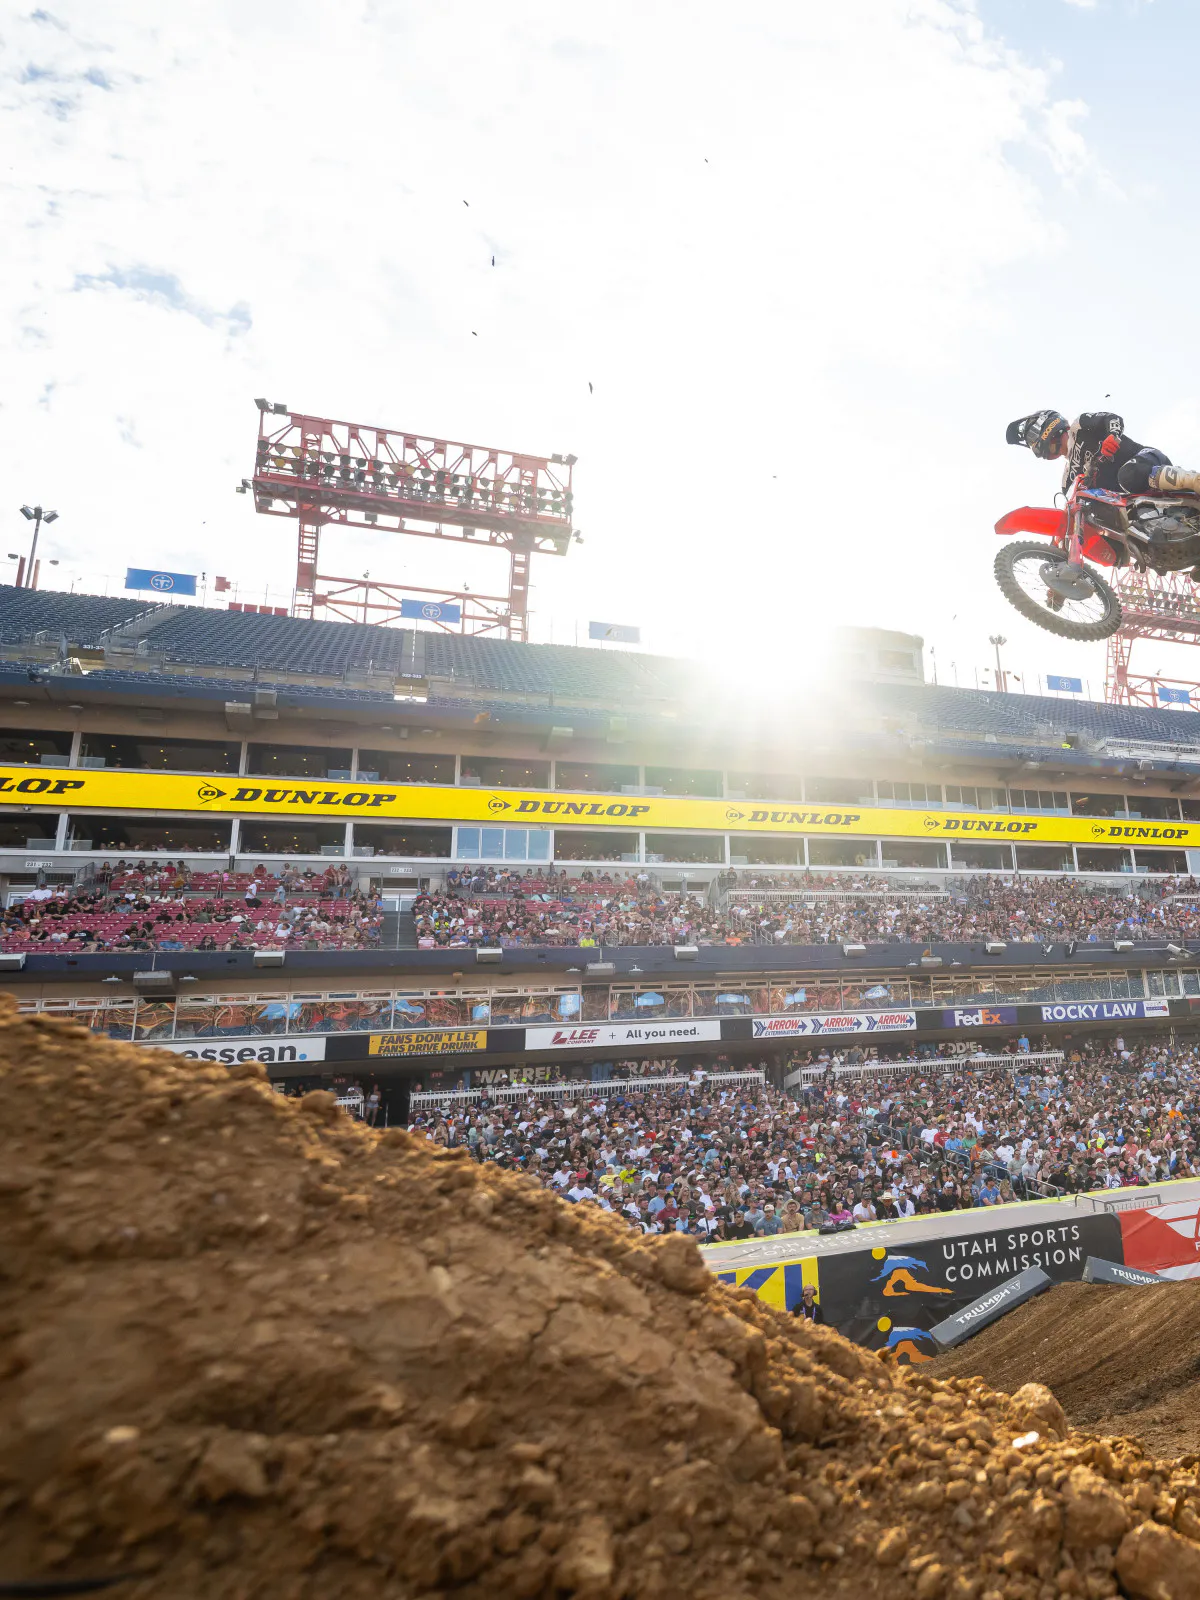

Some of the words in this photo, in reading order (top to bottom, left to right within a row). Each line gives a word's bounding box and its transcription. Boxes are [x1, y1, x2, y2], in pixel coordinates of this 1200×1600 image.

[230, 788, 397, 807] DUNLOP
[514, 800, 650, 817] DUNLOP
[748, 810, 860, 826] DUNLOP
[943, 819, 1037, 833] DUNLOP
[1108, 827, 1189, 839] DUNLOP
[954, 1009, 1001, 1027] FedEx
[1043, 1004, 1098, 1021] ROCKY
[1103, 1002, 1137, 1019] LAW
[766, 1020, 800, 1030] ARROW
[823, 1017, 856, 1027] ARROW
[877, 1014, 909, 1024] ARROW
[380, 1035, 413, 1045] FANS
[415, 1033, 456, 1043] DON'T
[456, 1031, 479, 1041] LET
[568, 1029, 600, 1041] LEE
[626, 1029, 642, 1039] All
[644, 1030, 667, 1041] you
[668, 1027, 700, 1038] need.
[377, 1044, 406, 1053] FANS
[407, 1042, 439, 1052] DRIVE
[441, 1041, 478, 1050] DRUNK
[567, 1038, 594, 1046] COMPANY
[942, 1238, 998, 1260] UTAH
[1007, 1225, 1080, 1249] SPORTS
[945, 1248, 1081, 1283] COMMISSION
[956, 1286, 1011, 1326] TRIUMPH
